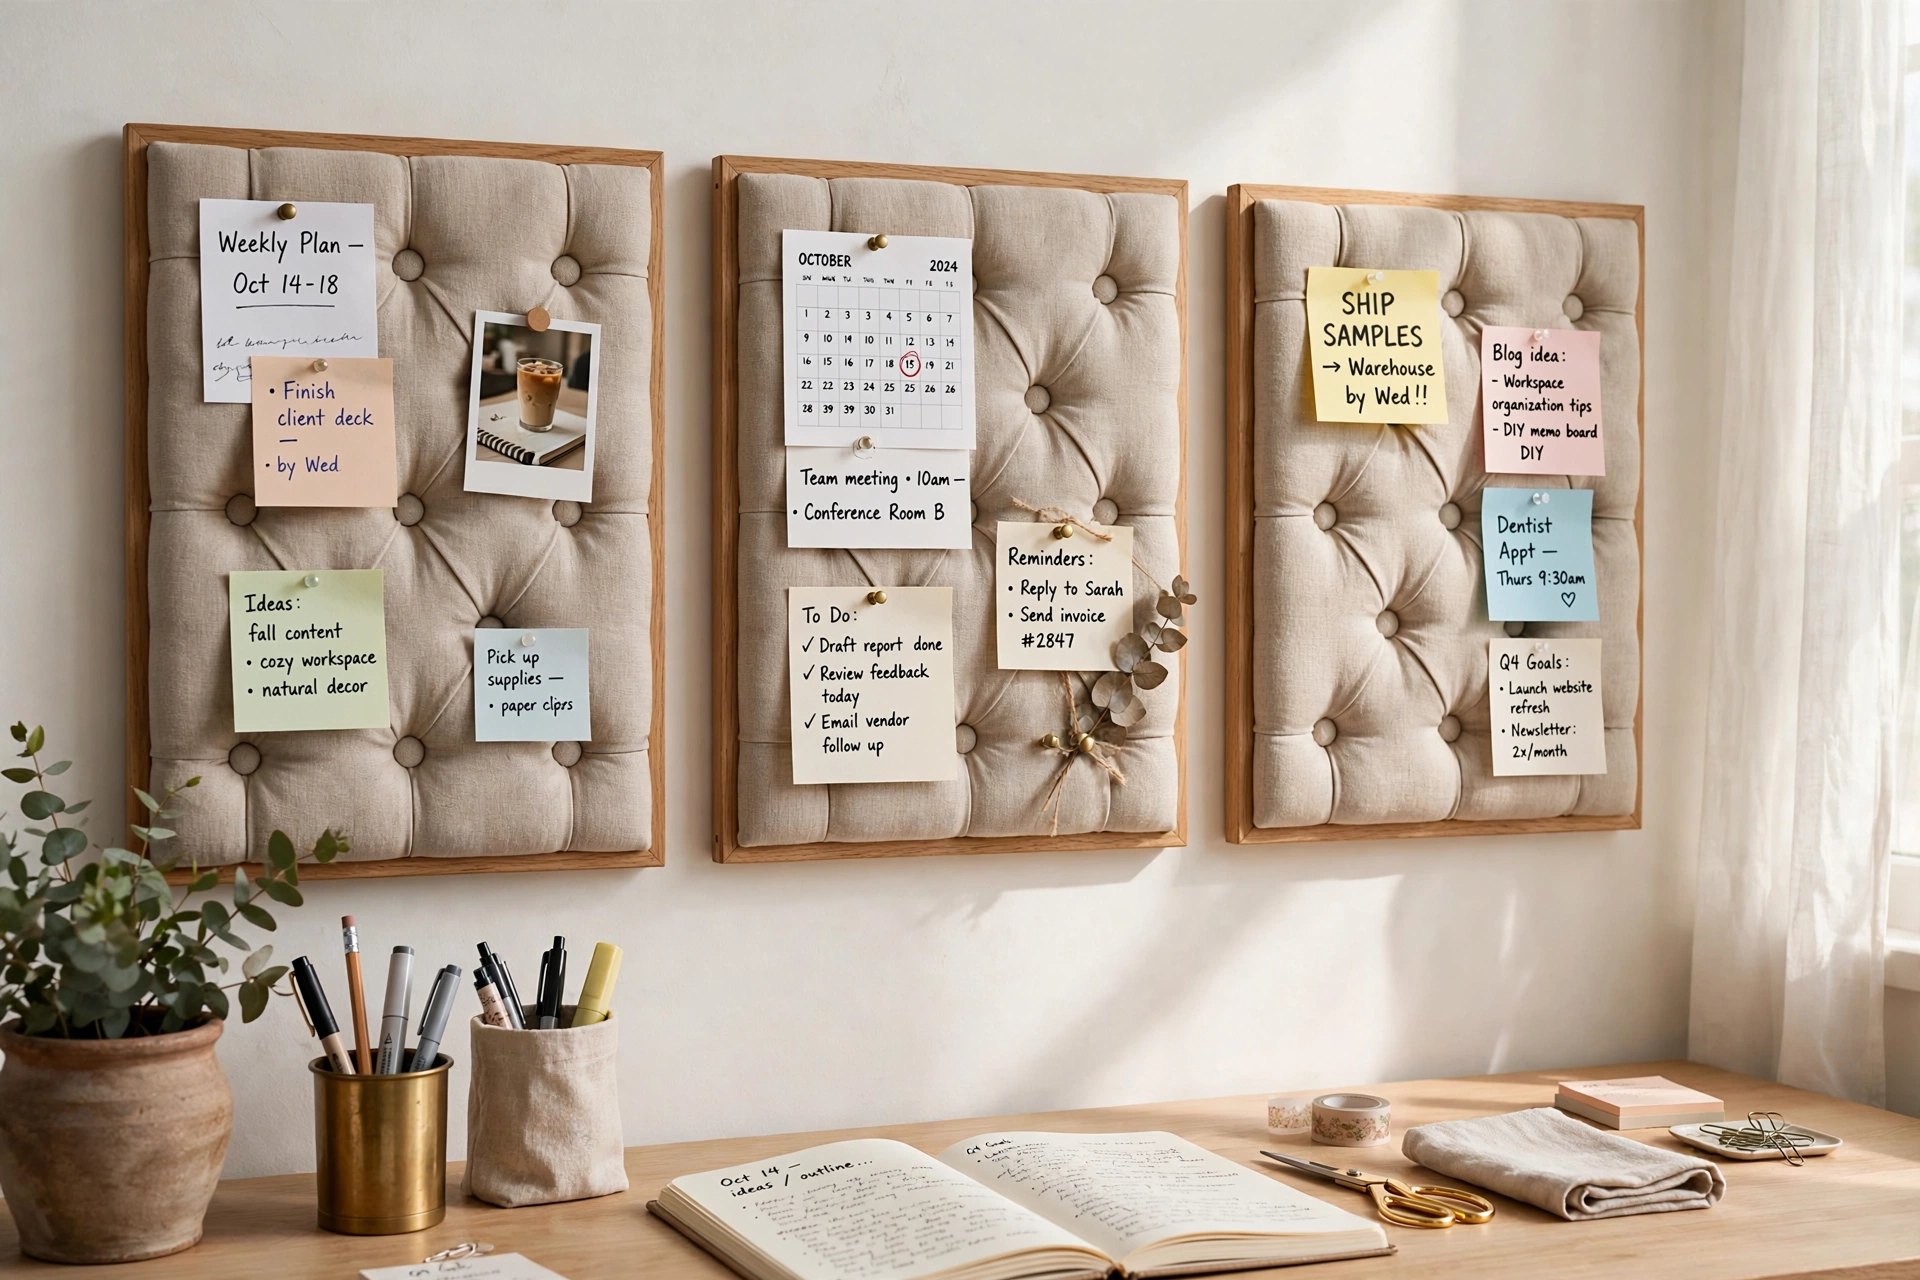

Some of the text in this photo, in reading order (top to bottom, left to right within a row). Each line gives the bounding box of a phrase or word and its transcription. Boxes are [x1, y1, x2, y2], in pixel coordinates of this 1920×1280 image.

[219, 231, 340, 263] Weekly Plan
[799, 253, 957, 272] OCTOBER 2024
[234, 272, 338, 294] Oct 14-18
[1342, 292, 1394, 315] SHIP
[804, 308, 953, 323] 1 2 3 3 4 5 6 7
[803, 333, 810, 343] 9
[823, 333, 833, 343] 10
[864, 335, 875, 345] 10
[885, 336, 893, 345] 11
[905, 336, 915, 346] 12
[925, 337, 936, 347] 13
[946, 338, 955, 347] 14
[1324, 323, 1422, 347] SAMPLES
[802, 356, 812, 365] 16
[823, 356, 833, 366] 15
[844, 357, 854, 367] 16
[865, 358, 874, 368] 17
[885, 359, 895, 368] 18
[905, 359, 915, 369] 15
[944, 360, 954, 370] 21
[1494, 343, 1565, 369] Blog idea:
[1349, 357, 1435, 376] Warehouse
[284, 381, 335, 399] Finish
[801, 380, 956, 394] 22 22 23 24 25 25 26 26
[1504, 374, 1564, 394] Workspace
[1346, 385, 1365, 414] by
[1493, 398, 1591, 417] organization tips
[278, 408, 373, 426] client deck
[864, 405, 876, 415] 30
[885, 406, 894, 416] 31
[1504, 422, 1597, 438] DIY memo board
[1521, 445, 1543, 460] DIY
[278, 455, 338, 480] by Wed
[800, 468, 949, 493] Team meeting 10am
[805, 502, 944, 520] Conference Room B
[1498, 516, 1552, 533] Dentist
[1009, 547, 1092, 566] Reminders:
[1500, 542, 1535, 565] Appt
[1497, 570, 1585, 585] Thurs 9:30am
[1021, 579, 1123, 602] Reply to Sarah
[244, 594, 300, 612] Ideas:
[802, 607, 856, 623] To Do:
[1021, 606, 1105, 622] Send invoice
[249, 622, 342, 642] fall content
[1022, 633, 1074, 648] #2847
[820, 636, 942, 657] Draft report done
[261, 650, 376, 675] cozy workspace
[488, 649, 539, 668] Pick up
[1500, 653, 1568, 671] Q4 Goals:
[488, 670, 541, 690] supplies
[821, 663, 929, 681] Review feedback
[263, 677, 368, 697] natural decor
[1510, 680, 1592, 694] Launch website
[822, 688, 859, 709] today
[1511, 699, 1550, 714] refresh
[502, 702, 536, 716] paper
[822, 711, 909, 729] Email vendor
[1512, 723, 1575, 736] Newsletter:
[823, 737, 884, 758] follow up
[1513, 743, 1567, 760] 2x/month
[721, 1167, 778, 1186] Oct 14
[732, 1182, 772, 1197] ideas
